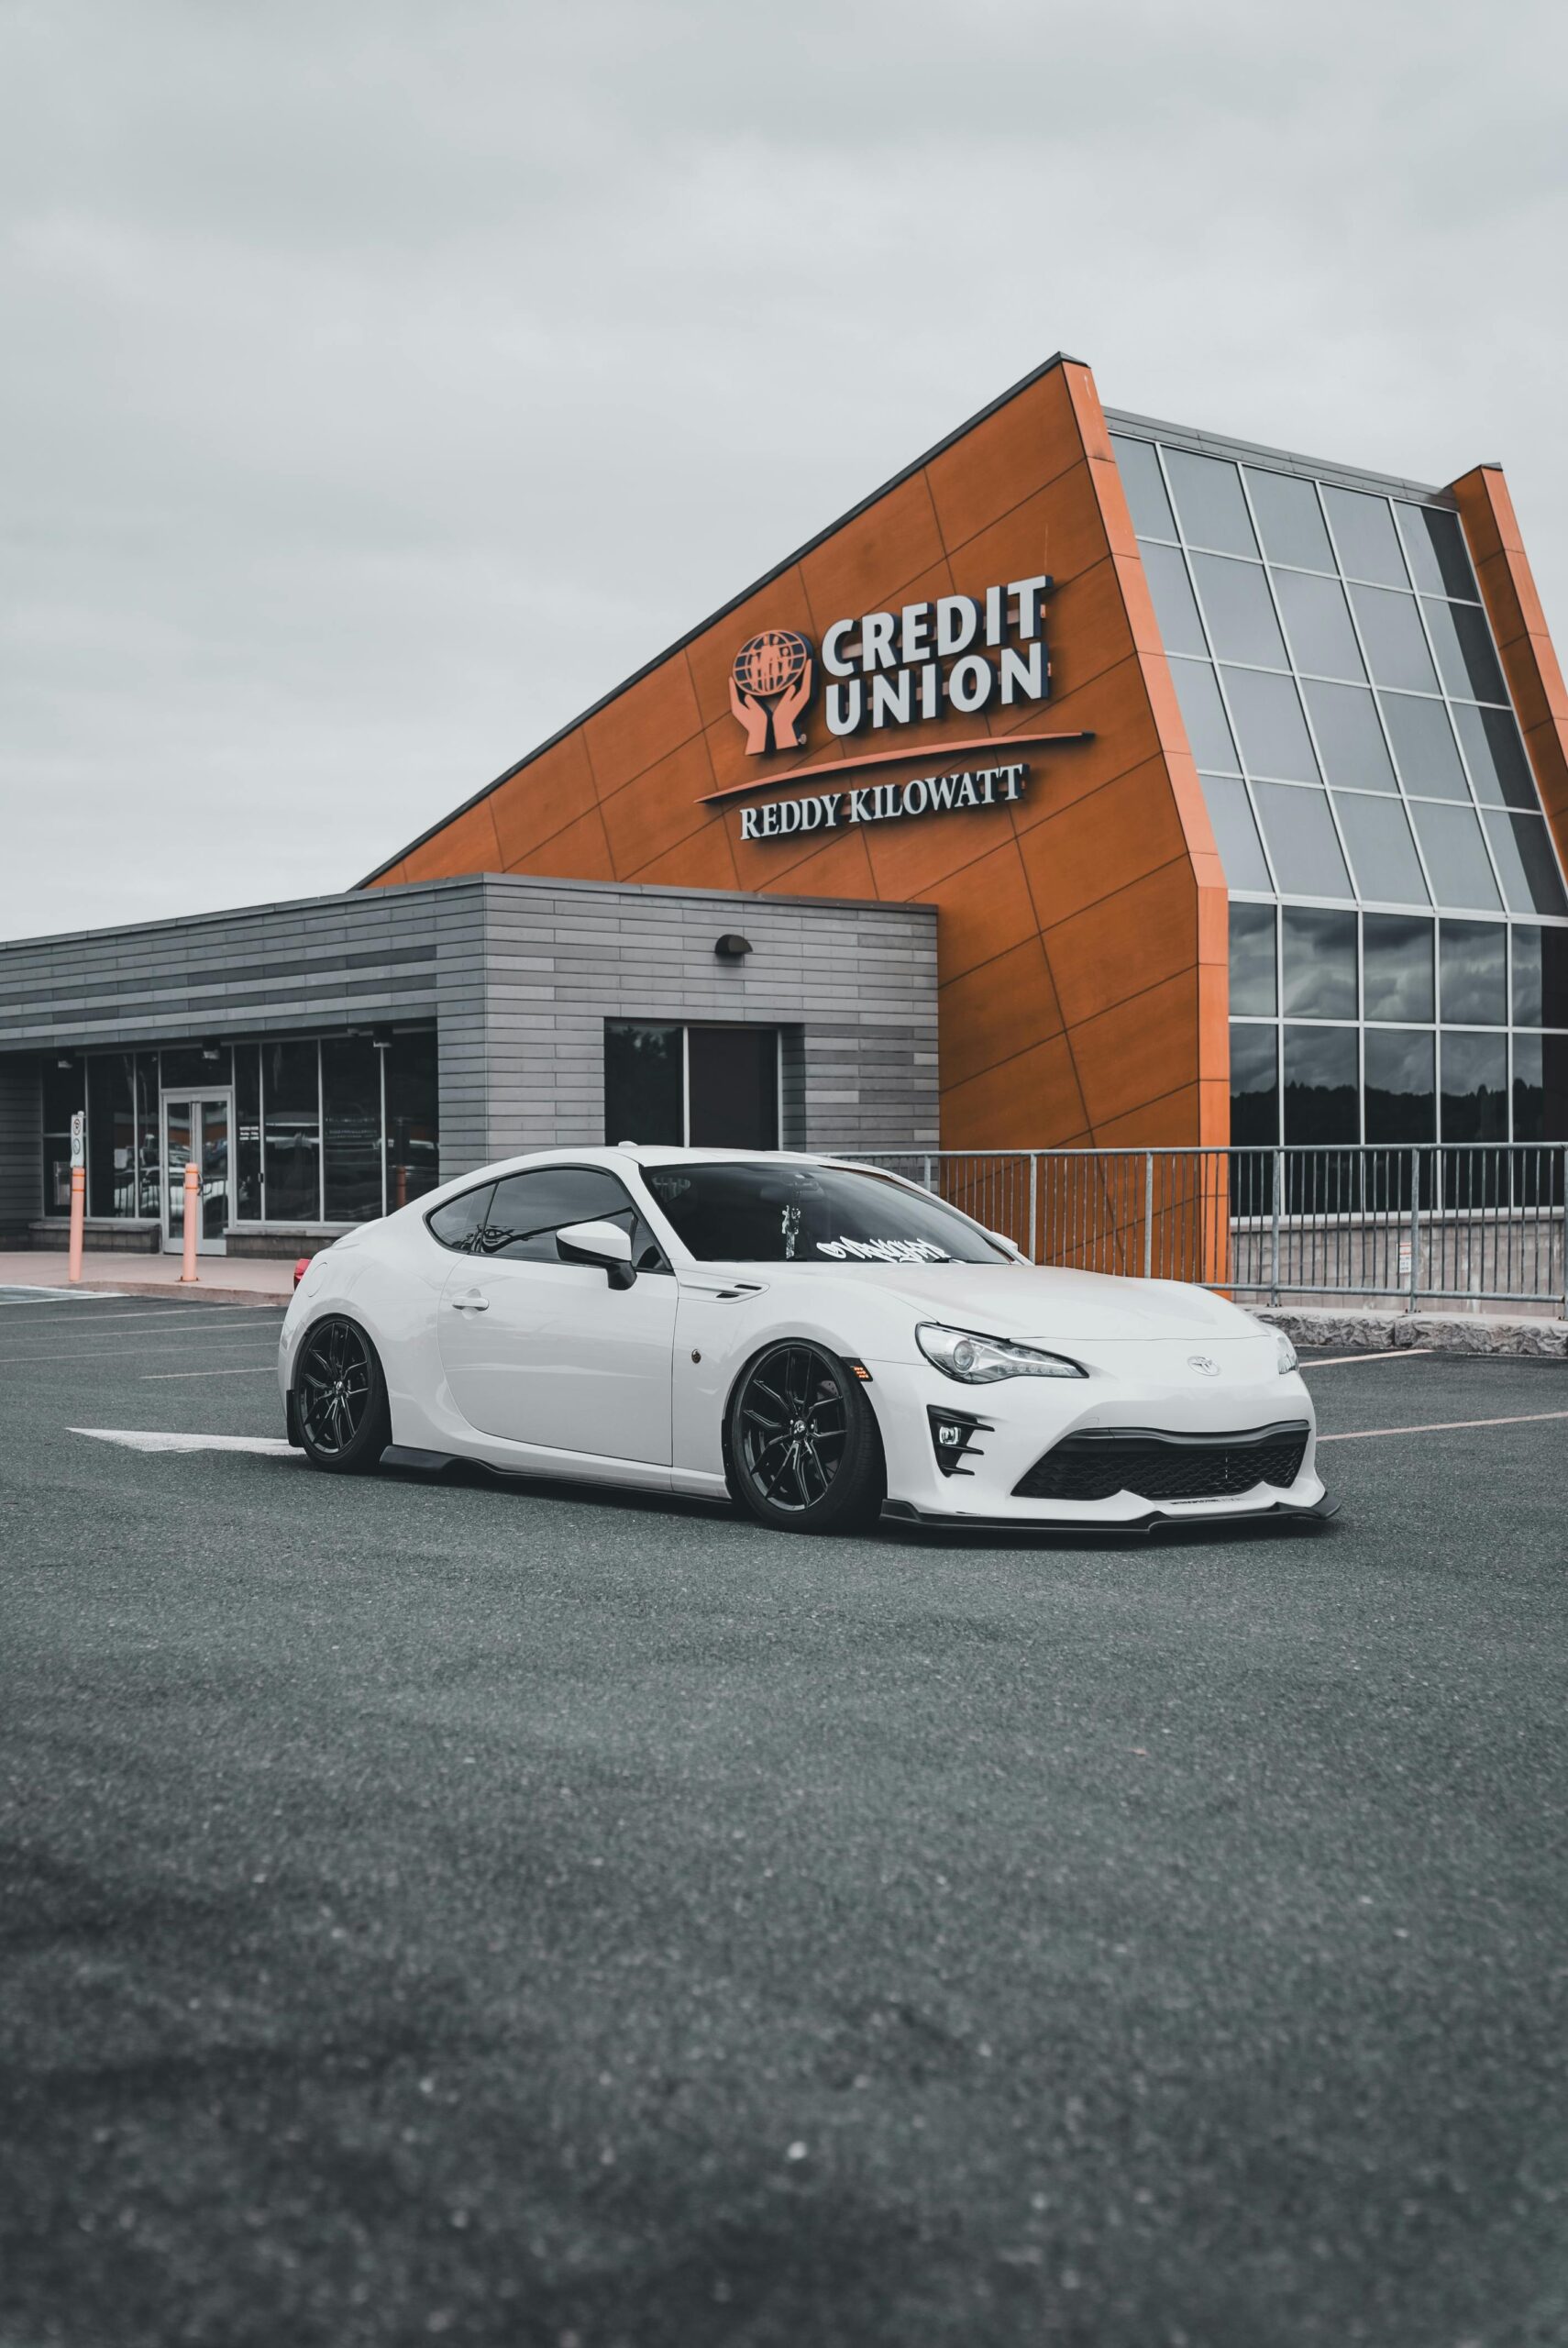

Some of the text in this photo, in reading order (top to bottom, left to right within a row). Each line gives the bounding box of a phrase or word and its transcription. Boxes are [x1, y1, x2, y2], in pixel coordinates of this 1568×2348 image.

[822, 575, 1049, 677] CREDIT
[825, 642, 1044, 736] UNION
[739, 763, 1025, 840] REDDY KILOWATT
